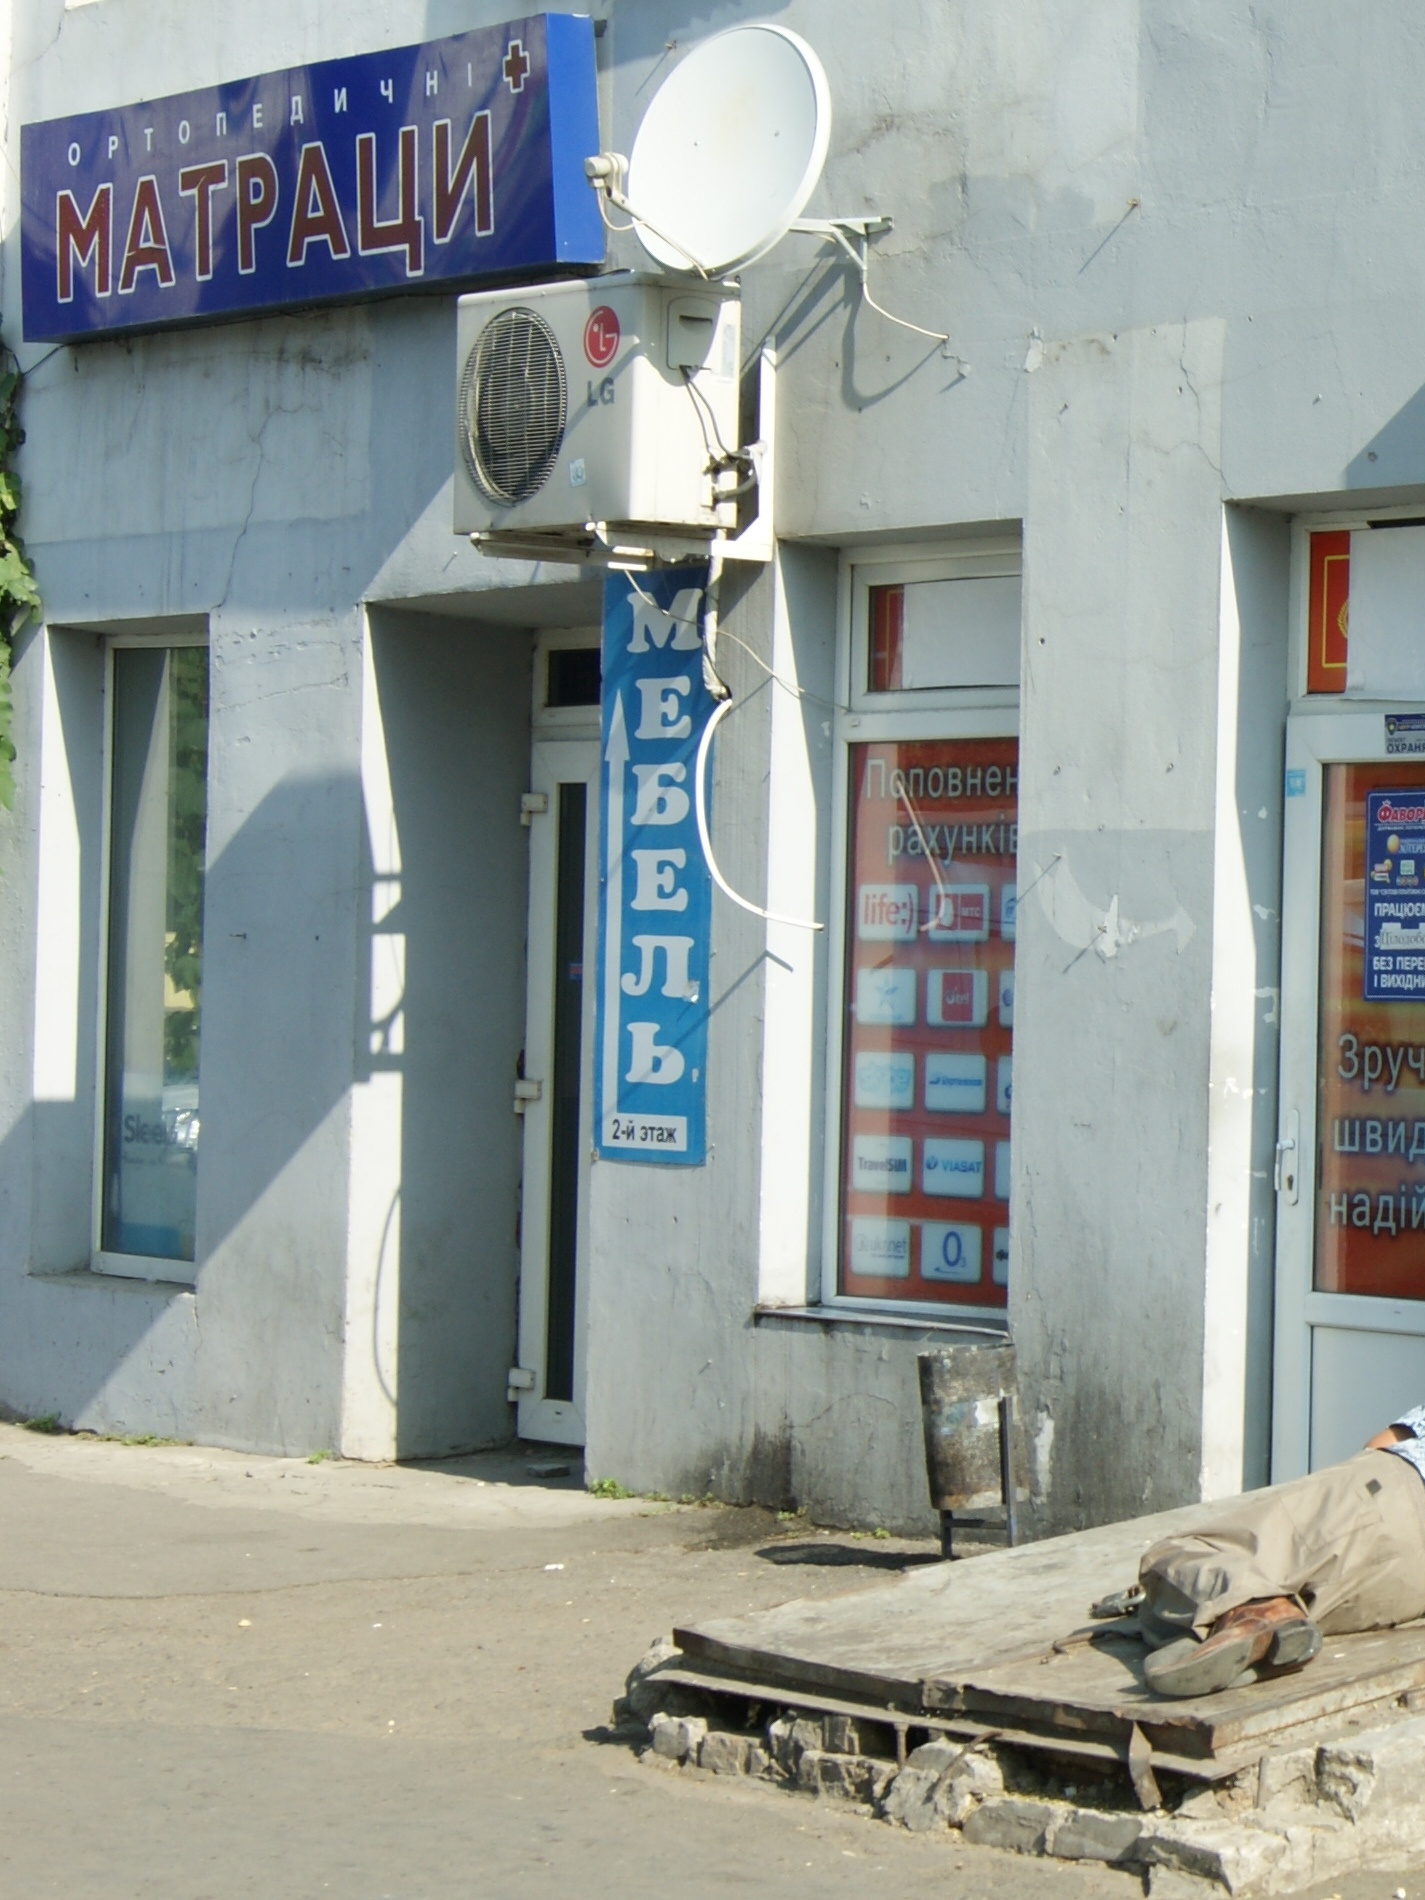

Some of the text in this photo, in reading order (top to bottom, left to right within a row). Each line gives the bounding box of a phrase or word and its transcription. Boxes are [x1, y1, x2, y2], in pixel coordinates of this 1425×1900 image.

[68, 63, 473, 167] ОРТОПЕДИЧНІ
[55, 110, 495, 304] МАТРАЦИ
[587, 377, 615, 407] LG
[865, 759, 1018, 798] Поповнен
[620, 587, 704, 1085] МЕБЕЛЬ
[1373, 957, 1393, 970] БЕЗ
[612, 1119, 676, 1143] 2-й этаж
[942, 1159, 982, 1173] VIASAT
